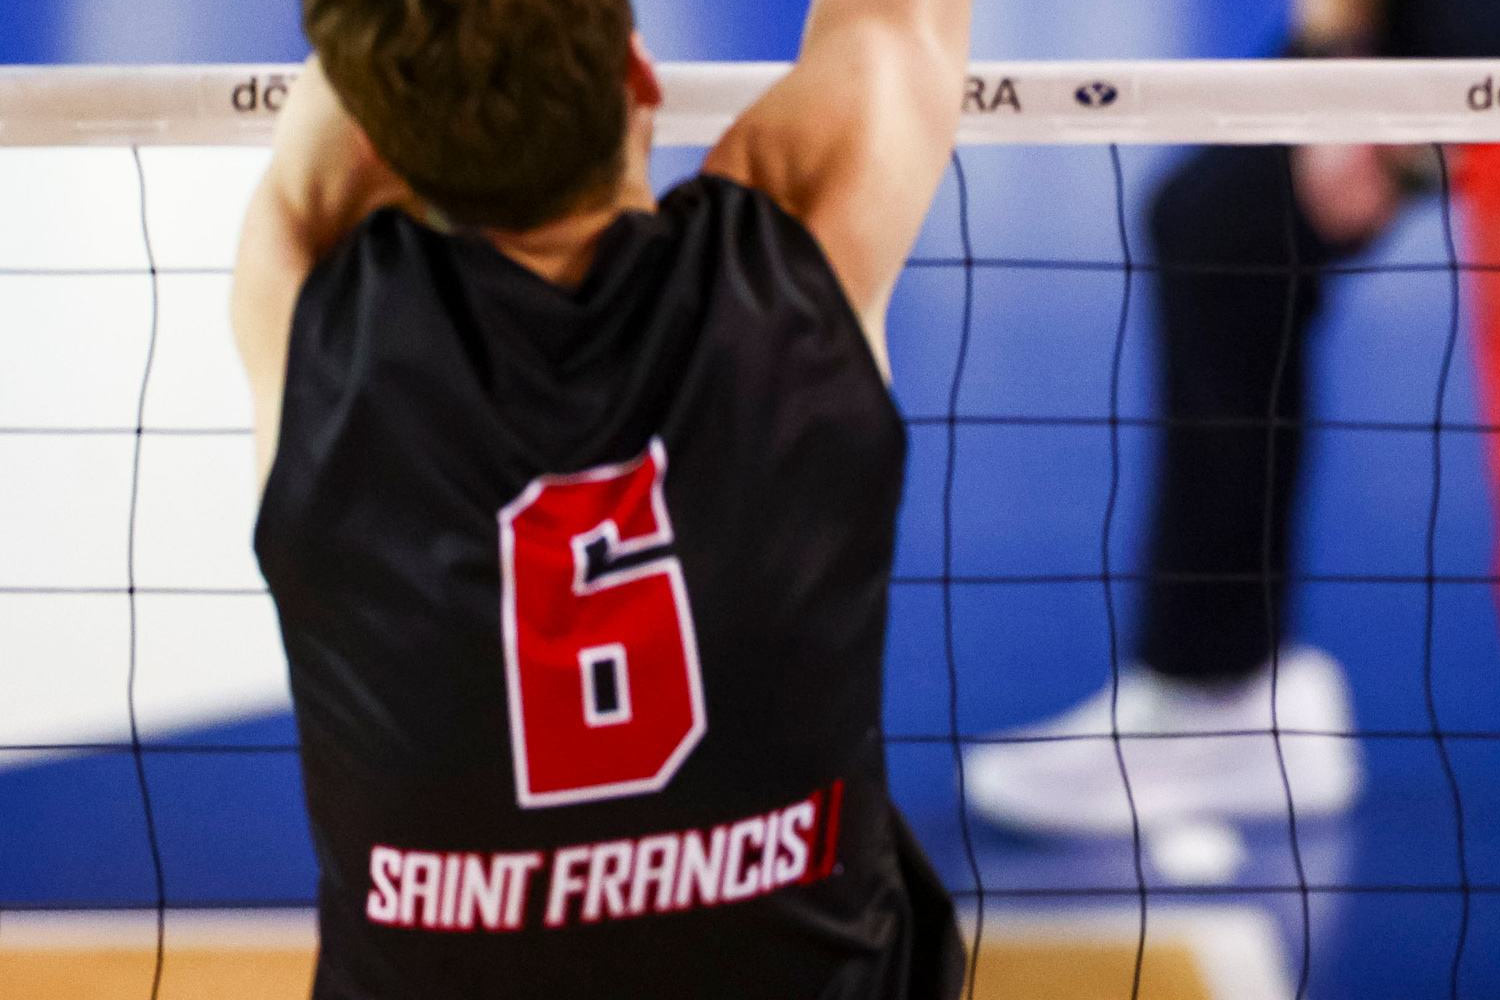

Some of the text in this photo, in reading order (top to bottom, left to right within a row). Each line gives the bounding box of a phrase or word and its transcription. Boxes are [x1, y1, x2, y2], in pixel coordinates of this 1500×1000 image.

[496, 434, 707, 809] 6
[366, 844, 546, 932] SAINT
[543, 799, 817, 930] FRANCIS
